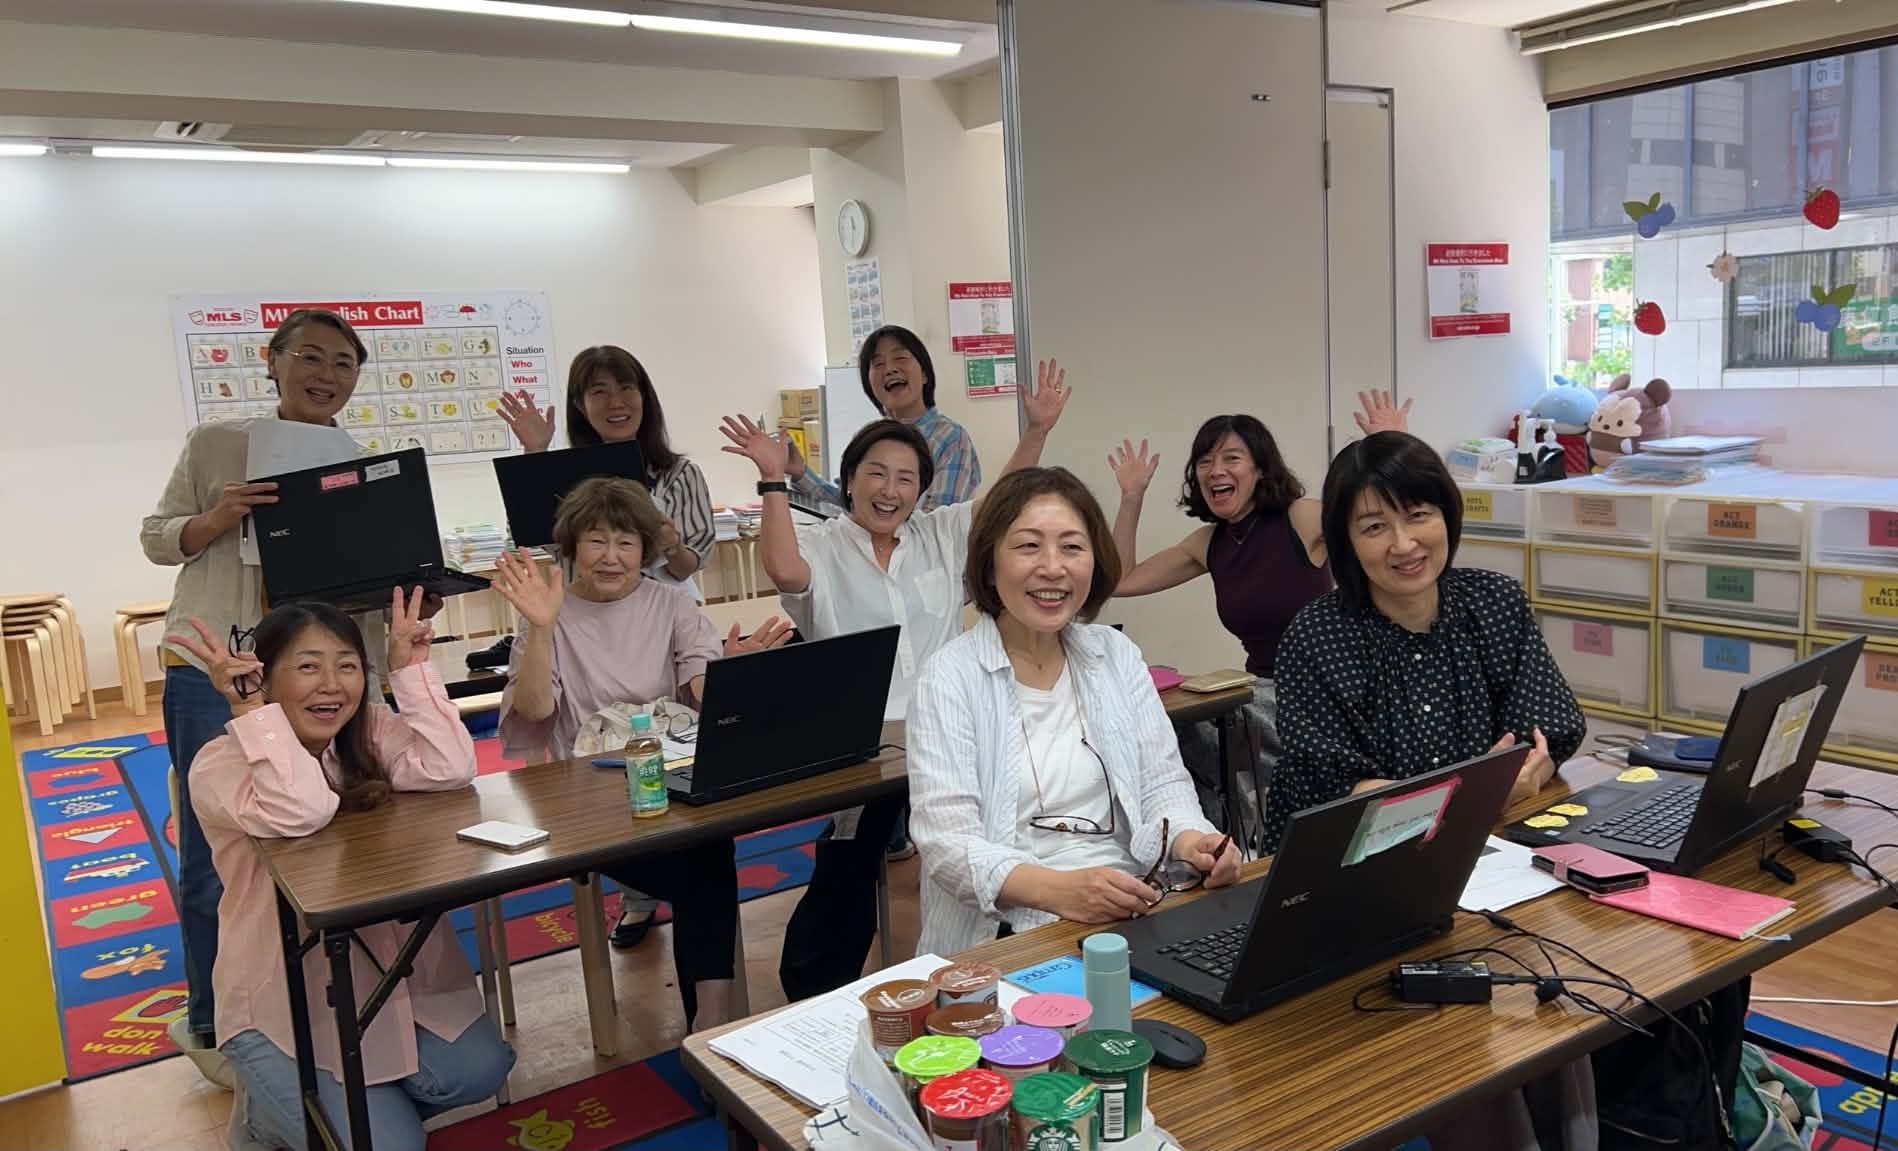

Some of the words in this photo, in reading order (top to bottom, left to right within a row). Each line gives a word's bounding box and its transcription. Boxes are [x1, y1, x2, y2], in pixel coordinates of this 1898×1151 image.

[207, 312, 242, 321] MLS
[375, 306, 420, 321] Chart
[464, 340, 475, 350] G
[506, 346, 545, 355] Situation
[245, 347, 256, 358] B
[511, 360, 533, 369] Who
[386, 375, 395, 386] L
[427, 373, 439, 384] M
[469, 371, 480, 381] N
[513, 376, 539, 384] What
[200, 382, 213, 393] H
[390, 407, 399, 417] S
[430, 404, 440, 415] T
[269, 528, 290, 537] NEC
[717, 713, 742, 726] NEC
[48, 790, 119, 806] grapes
[51, 819, 134, 838] triangle
[71, 852, 137, 870] boat
[70, 889, 159, 913] green
[1280, 892, 1311, 908] NEC
[536, 911, 576, 944] bicycle
[95, 944, 156, 961] fox
[82, 1042, 162, 1055] walk
